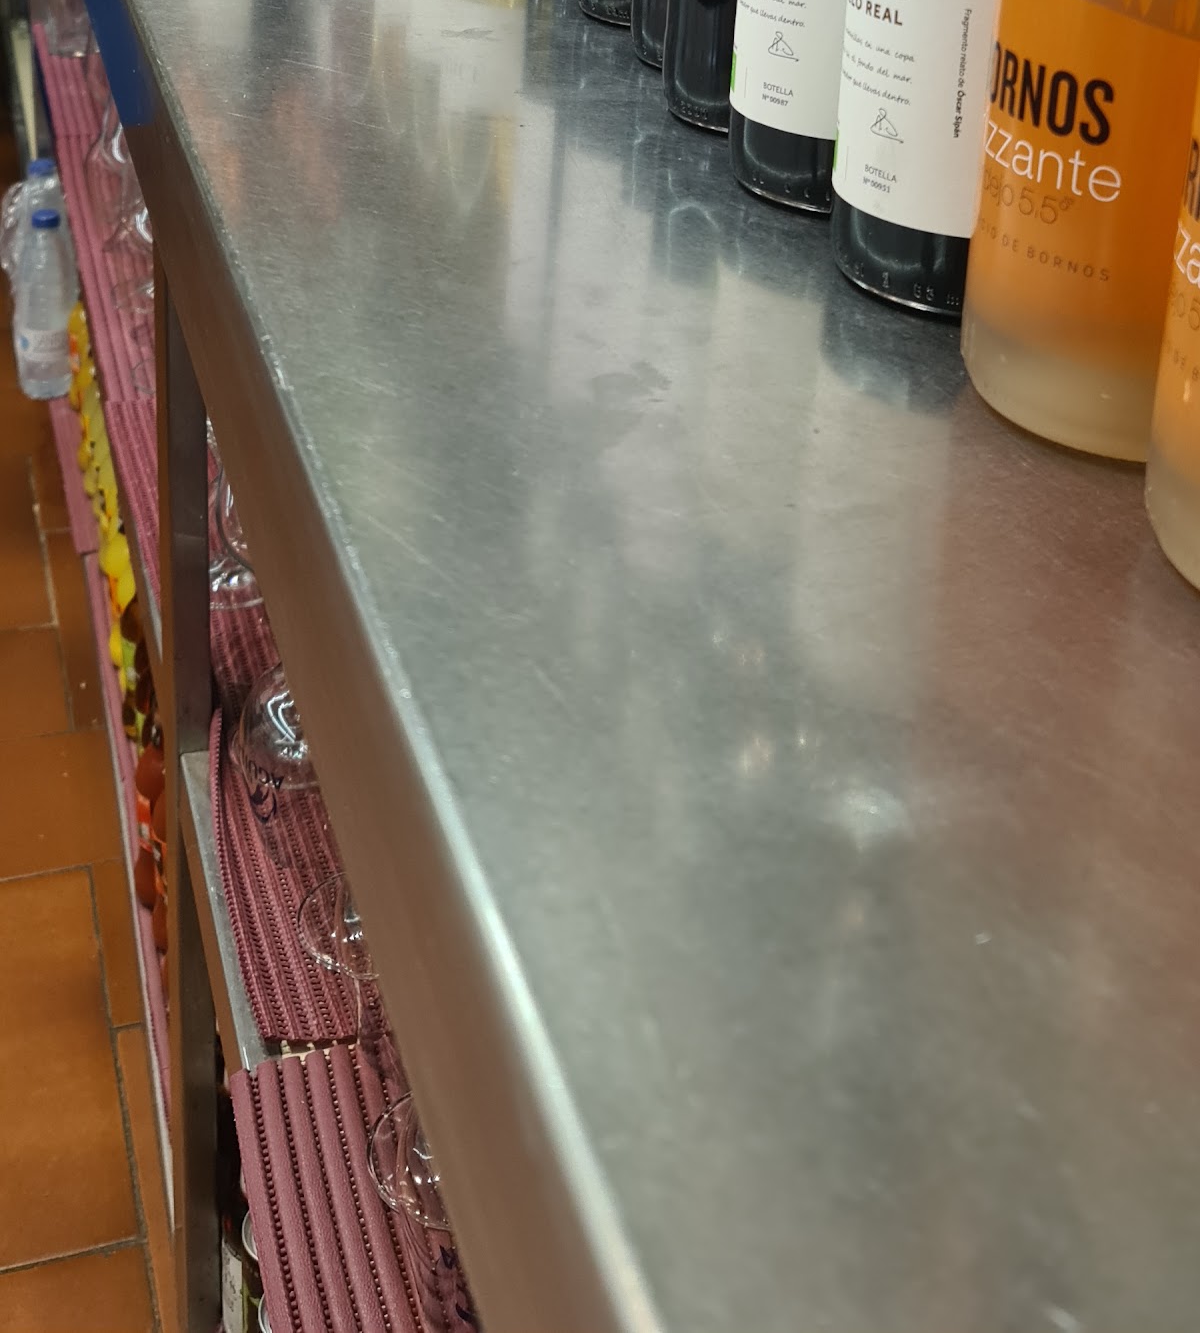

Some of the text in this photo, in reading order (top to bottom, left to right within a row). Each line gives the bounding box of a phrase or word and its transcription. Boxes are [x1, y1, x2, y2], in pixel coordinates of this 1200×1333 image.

[865, 0, 904, 26] REAL
[762, 80, 795, 98] BOTELLA
[864, 163, 898, 184] BOTELLA
[1025, 245, 1111, 283] BORNOS
